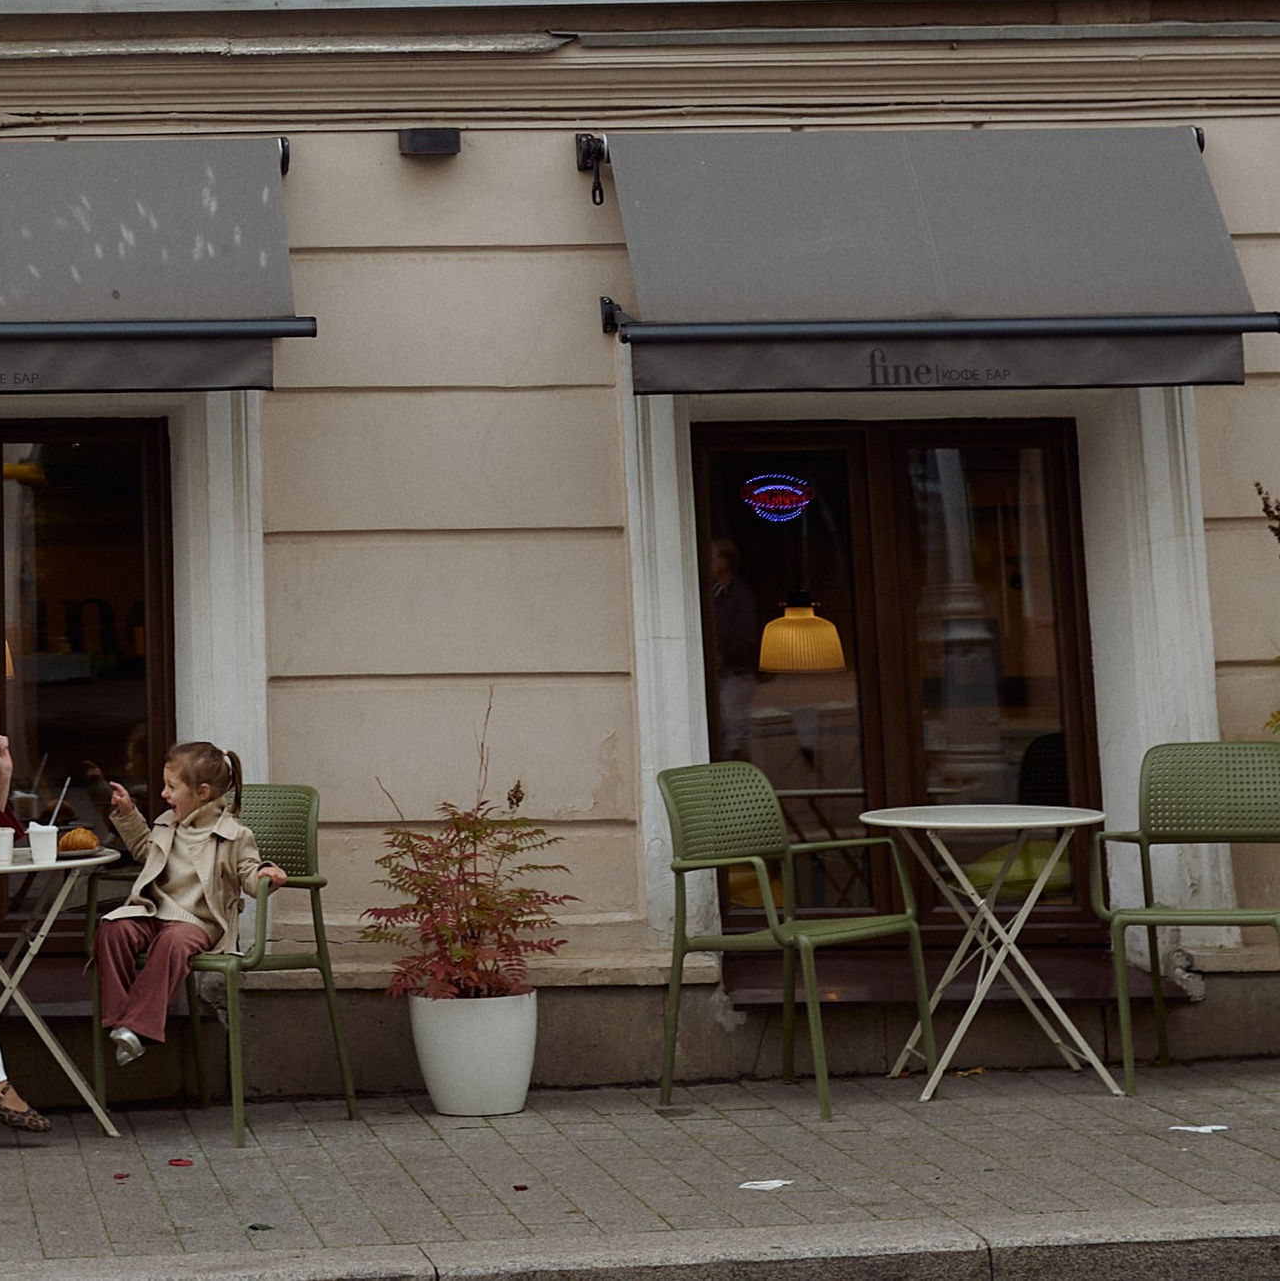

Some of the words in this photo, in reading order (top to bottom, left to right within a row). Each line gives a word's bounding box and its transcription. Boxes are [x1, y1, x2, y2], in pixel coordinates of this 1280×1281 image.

[13, 372, 40, 384] БАР
[867, 348, 933, 385] fine
[941, 369, 980, 381] КОФЕ
[986, 369, 1011, 380] БАР
